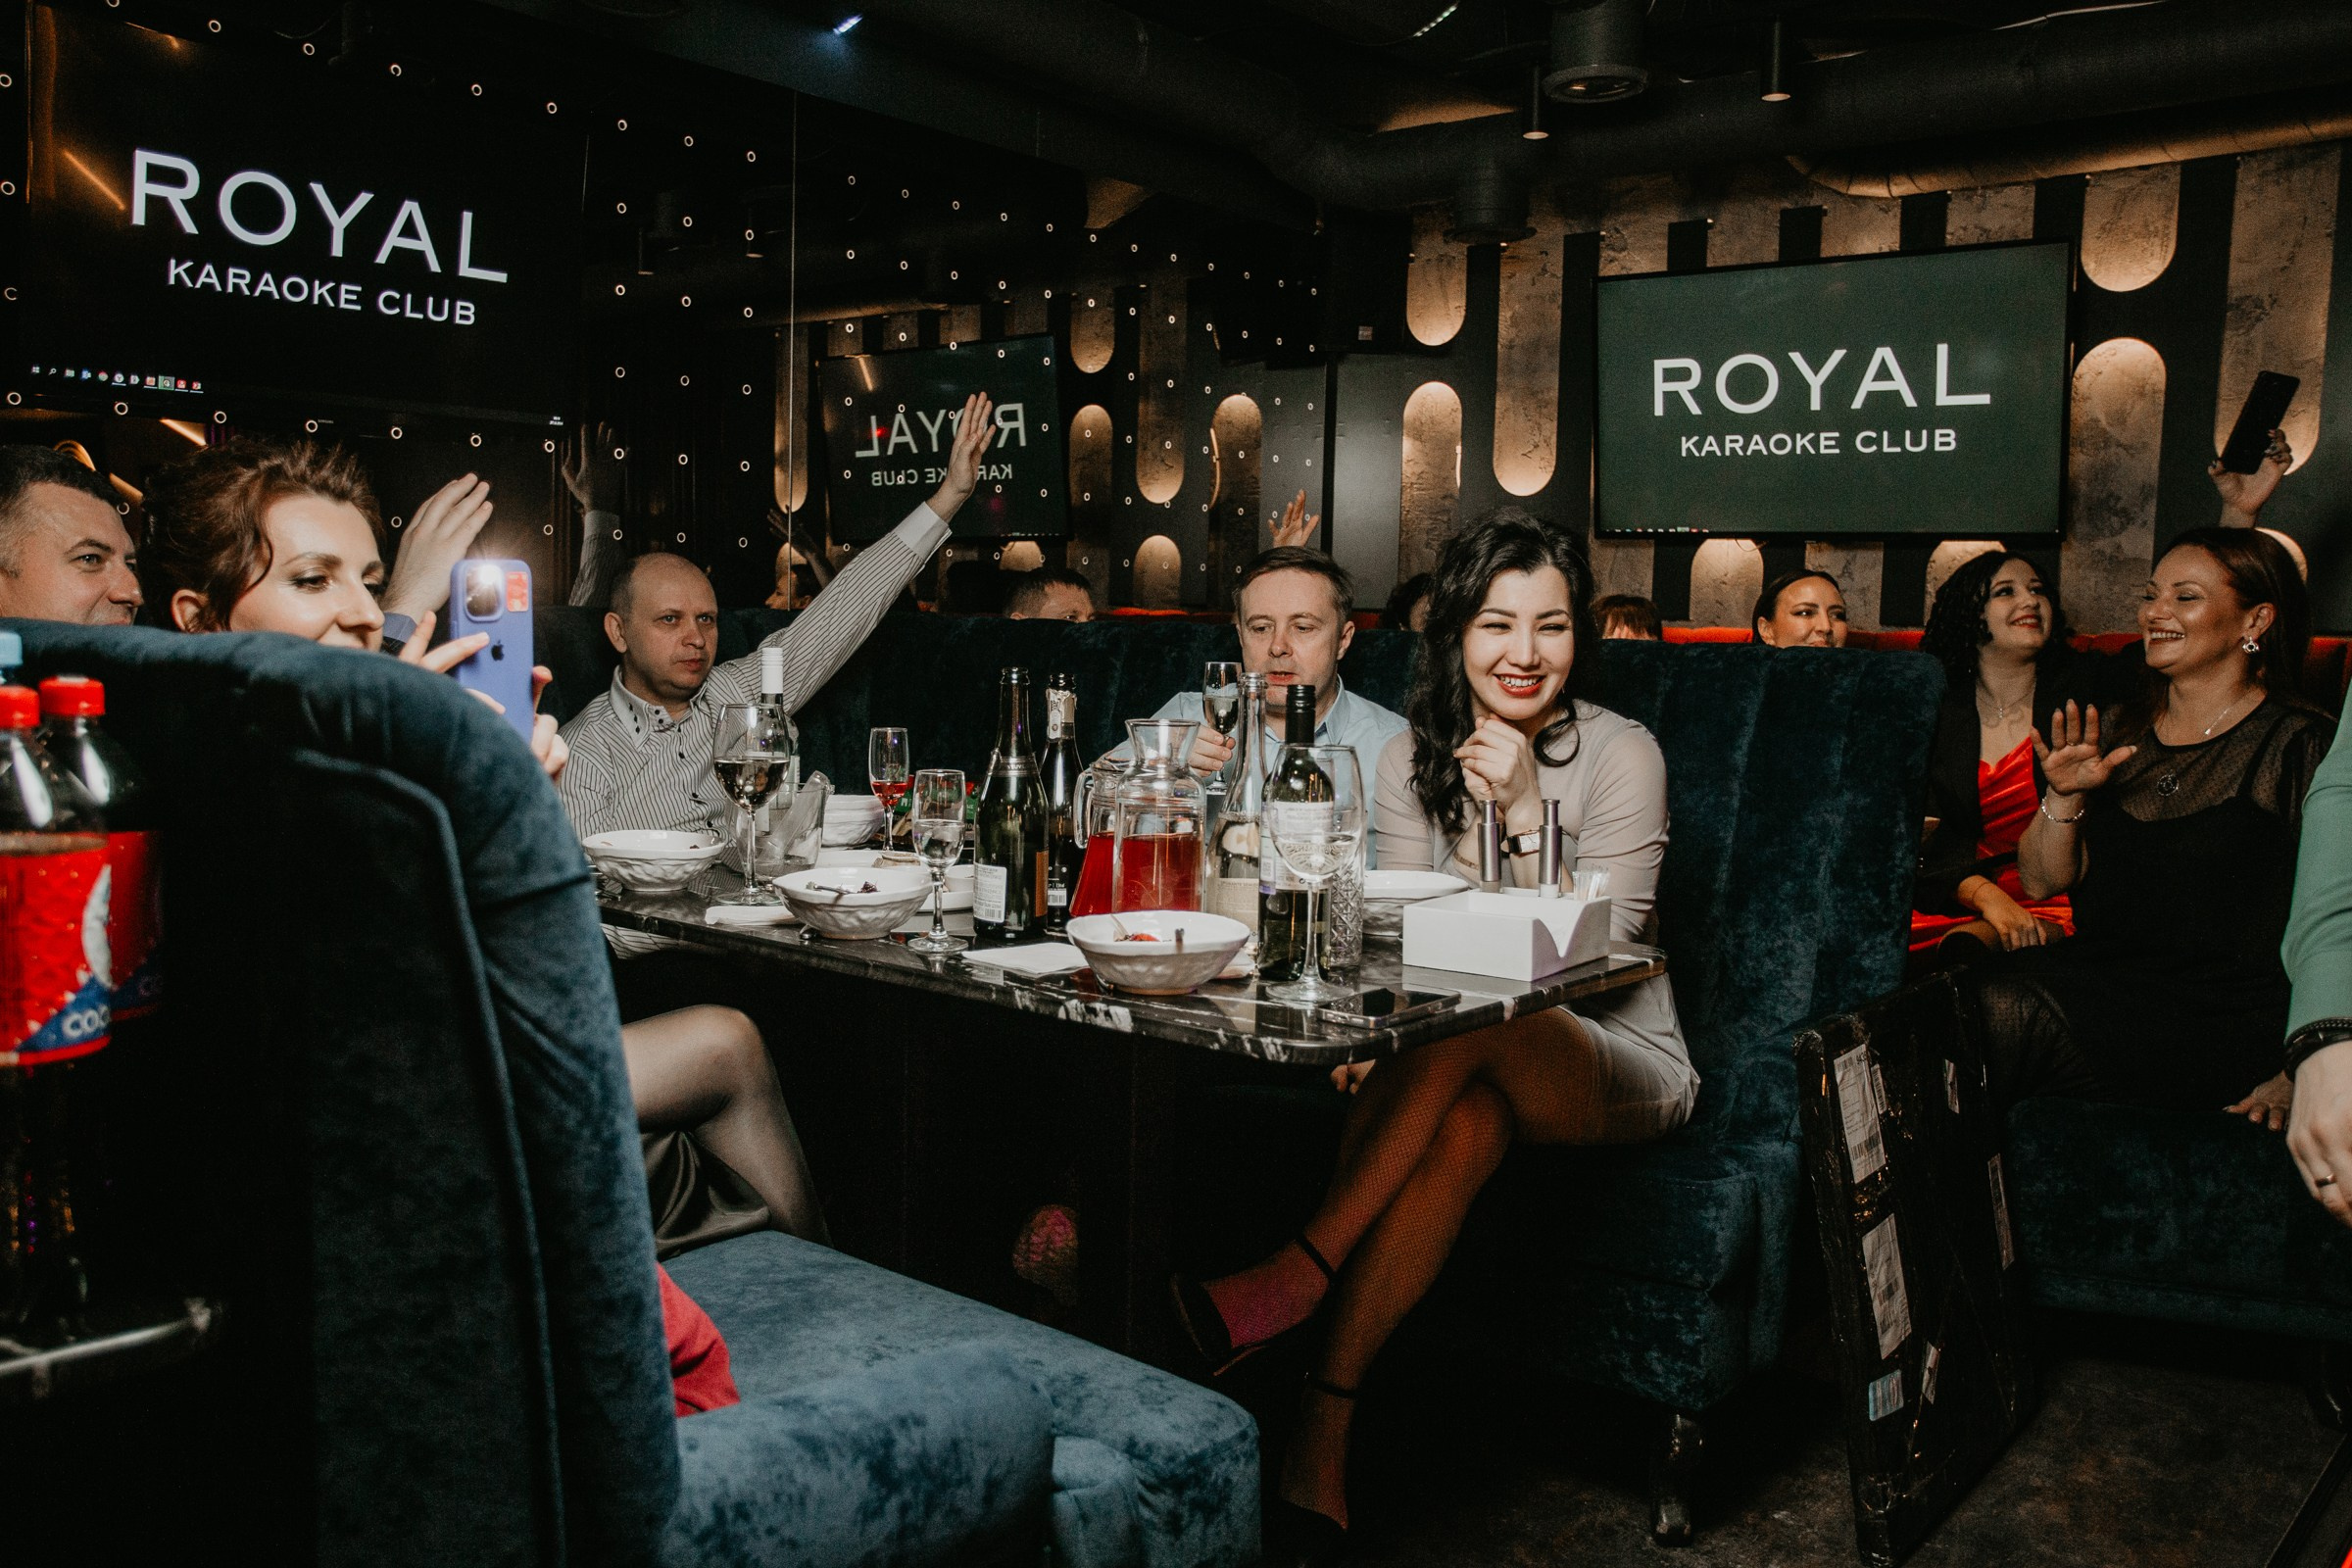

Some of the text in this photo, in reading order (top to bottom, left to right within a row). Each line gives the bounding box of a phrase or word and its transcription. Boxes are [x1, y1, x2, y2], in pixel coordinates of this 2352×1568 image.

[131, 148, 509, 283] ROYAL
[168, 258, 476, 325] KARAOKE CLUB
[1653, 342, 1991, 416] ROYAL
[1681, 428, 1957, 458] KARAOKE CLUB
